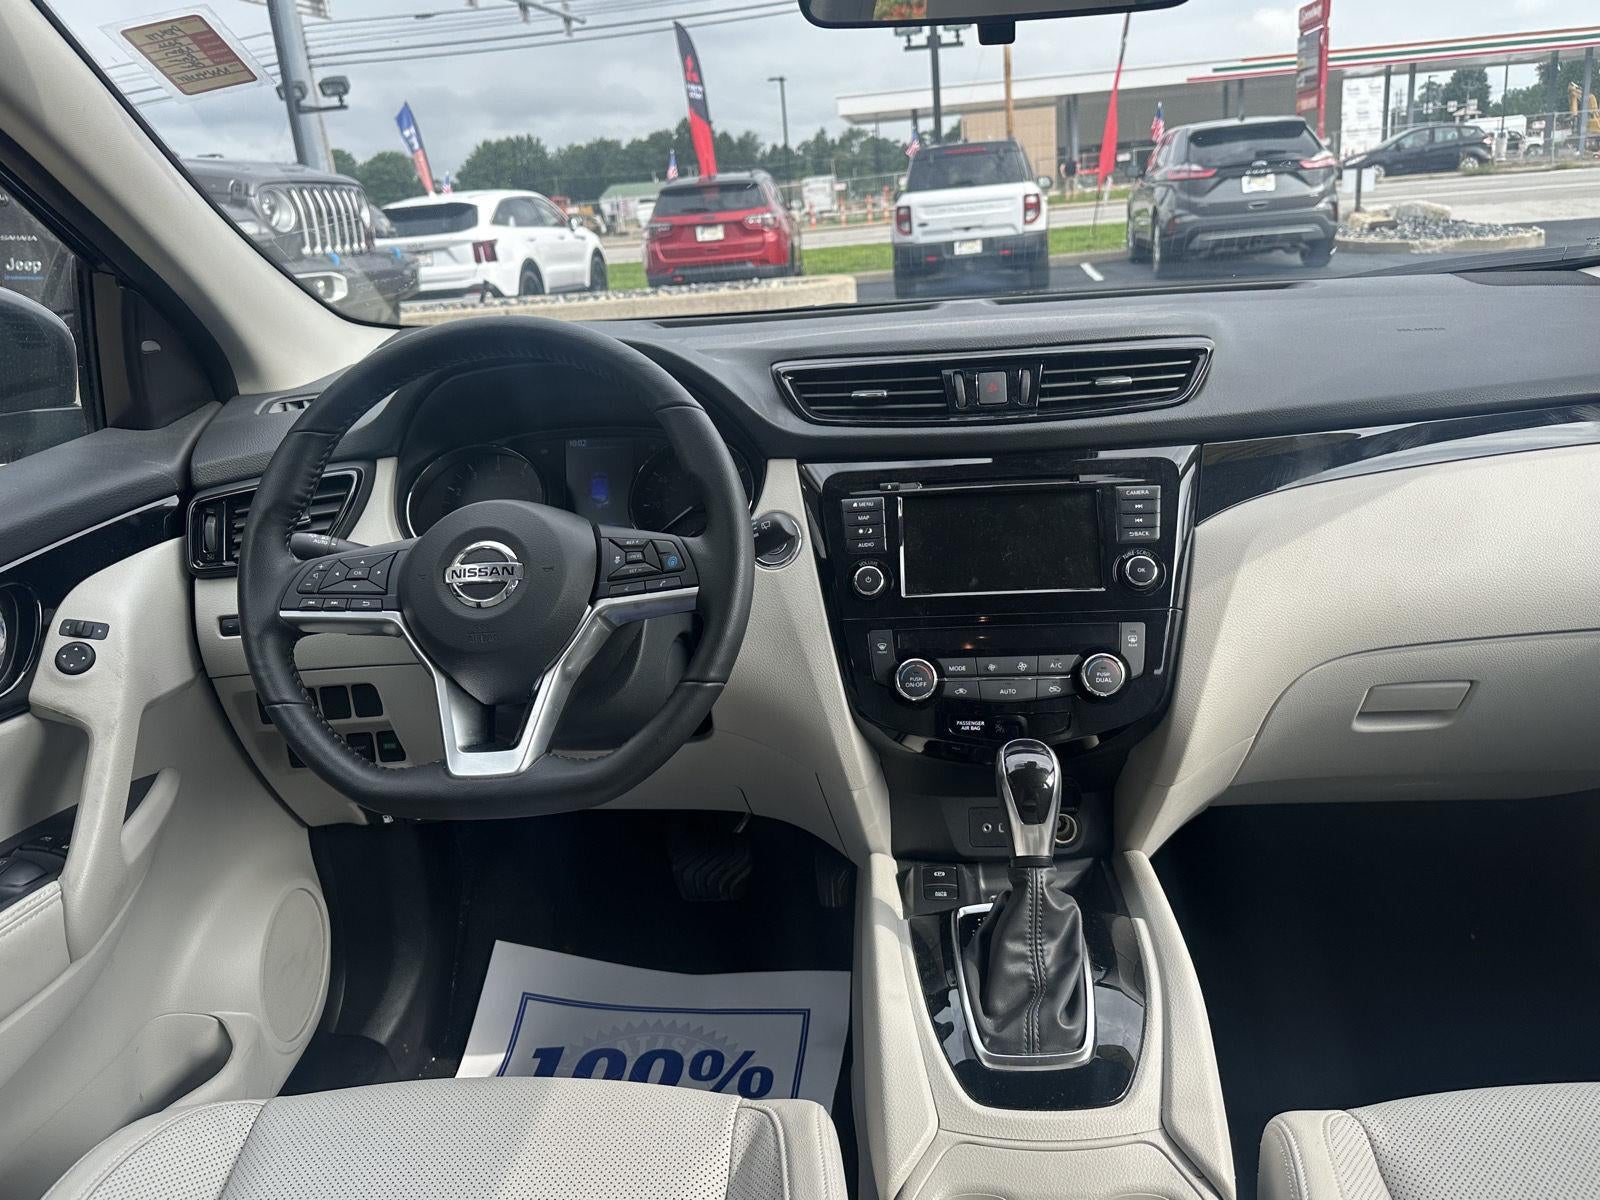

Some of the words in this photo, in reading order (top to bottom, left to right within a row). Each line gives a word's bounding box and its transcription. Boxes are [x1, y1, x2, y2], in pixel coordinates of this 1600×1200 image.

[5, 257, 42, 274] Jeep
[451, 566, 515, 580] NISSAN
[531, 1046, 774, 1099] 100%
